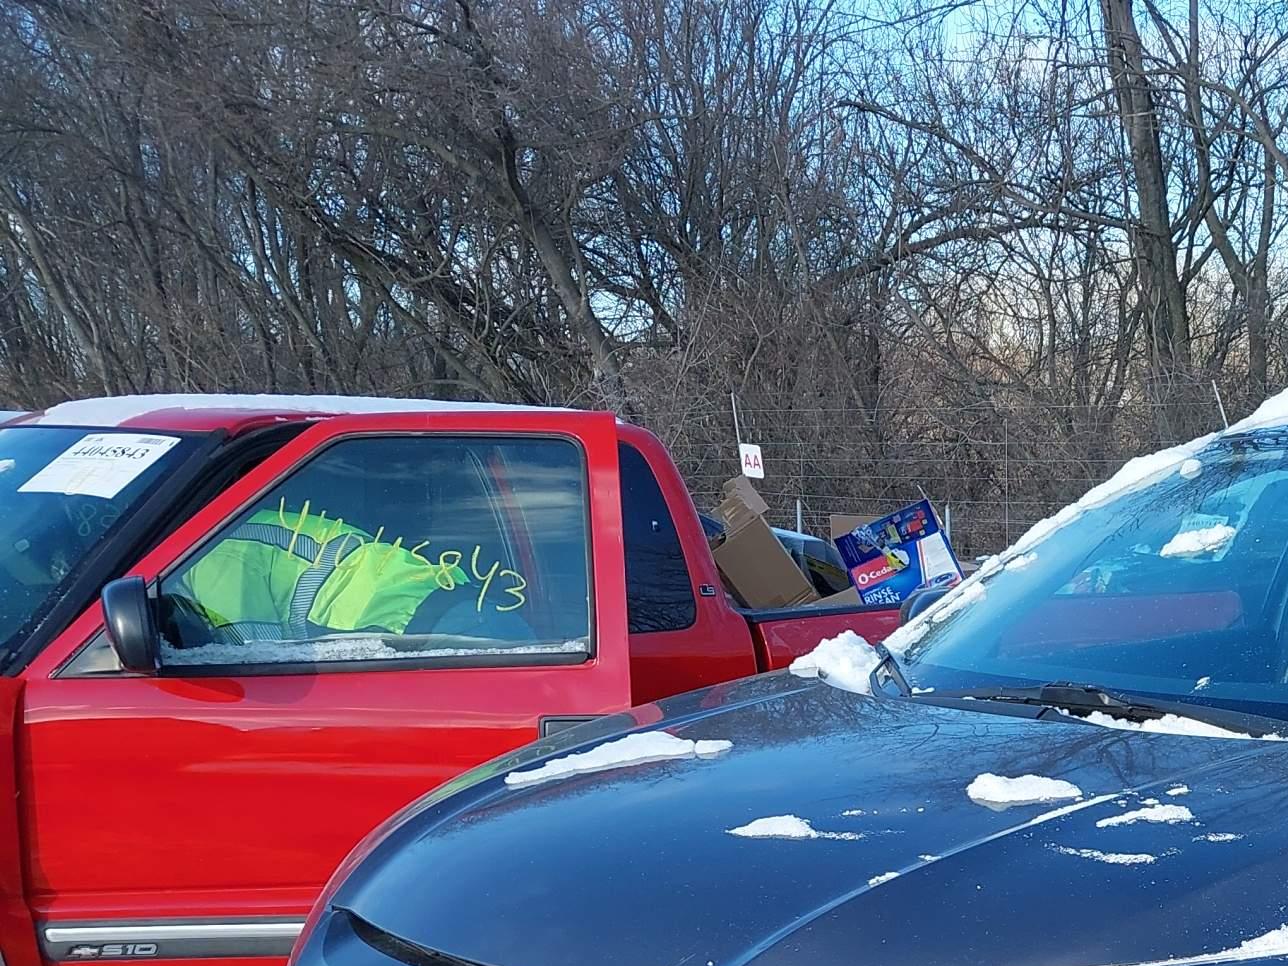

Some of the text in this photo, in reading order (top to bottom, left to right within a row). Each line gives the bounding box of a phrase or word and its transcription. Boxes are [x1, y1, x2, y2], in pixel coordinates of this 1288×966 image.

[73, 446, 150, 460] 44045843
[744, 453, 761, 469] AA
[858, 566, 894, 584] O-Ceda
[864, 586, 894, 605] RINSE
[101, 943, 157, 955] S10
